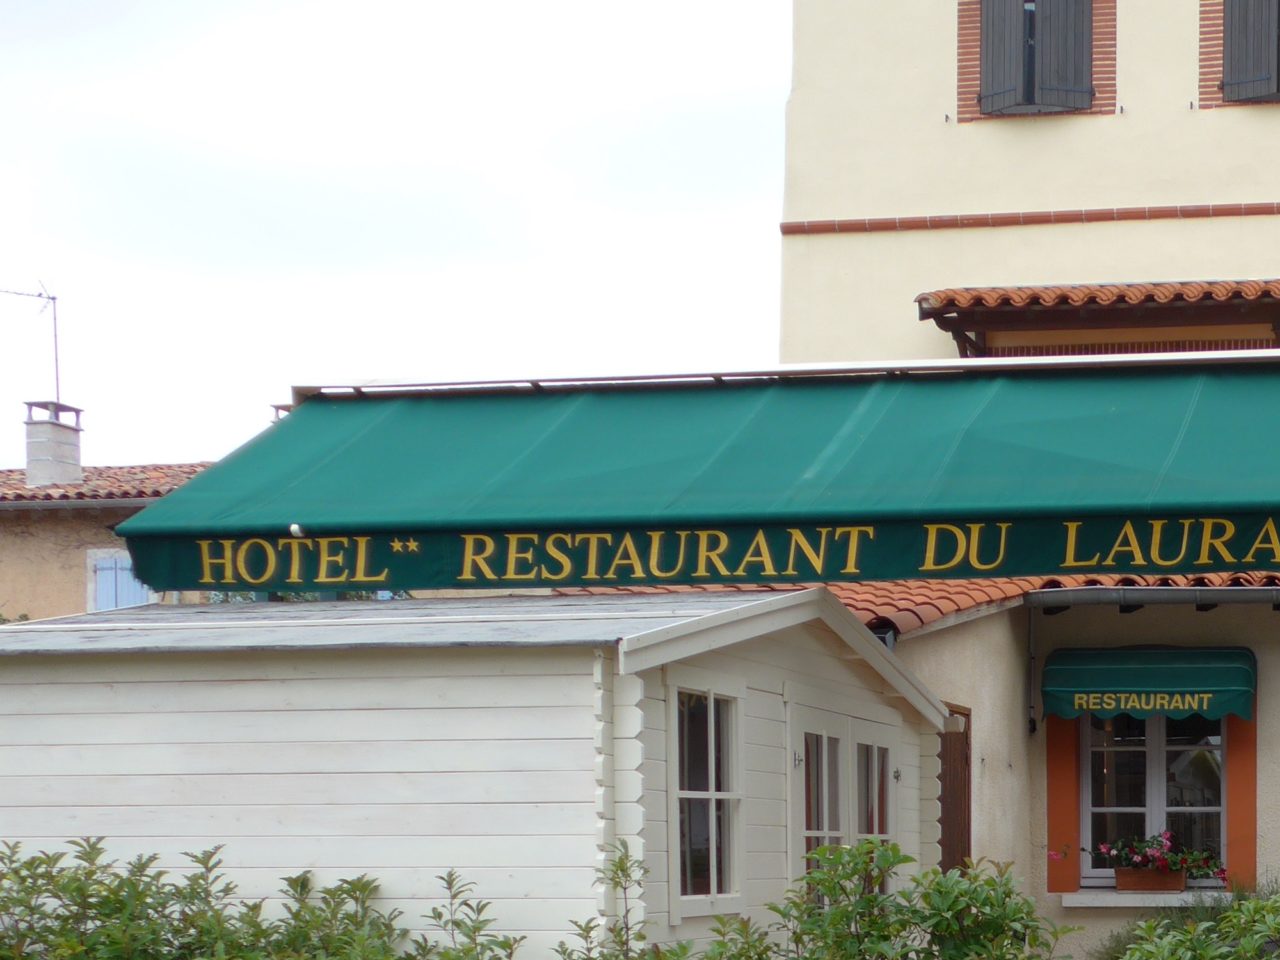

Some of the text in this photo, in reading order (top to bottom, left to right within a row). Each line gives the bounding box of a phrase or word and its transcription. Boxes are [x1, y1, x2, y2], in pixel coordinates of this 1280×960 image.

[197, 536, 388, 584] HOTEL
[456, 525, 875, 581] RESTAURANT
[919, 522, 1012, 571] DU
[1074, 693, 1213, 710] RESTAURANT
